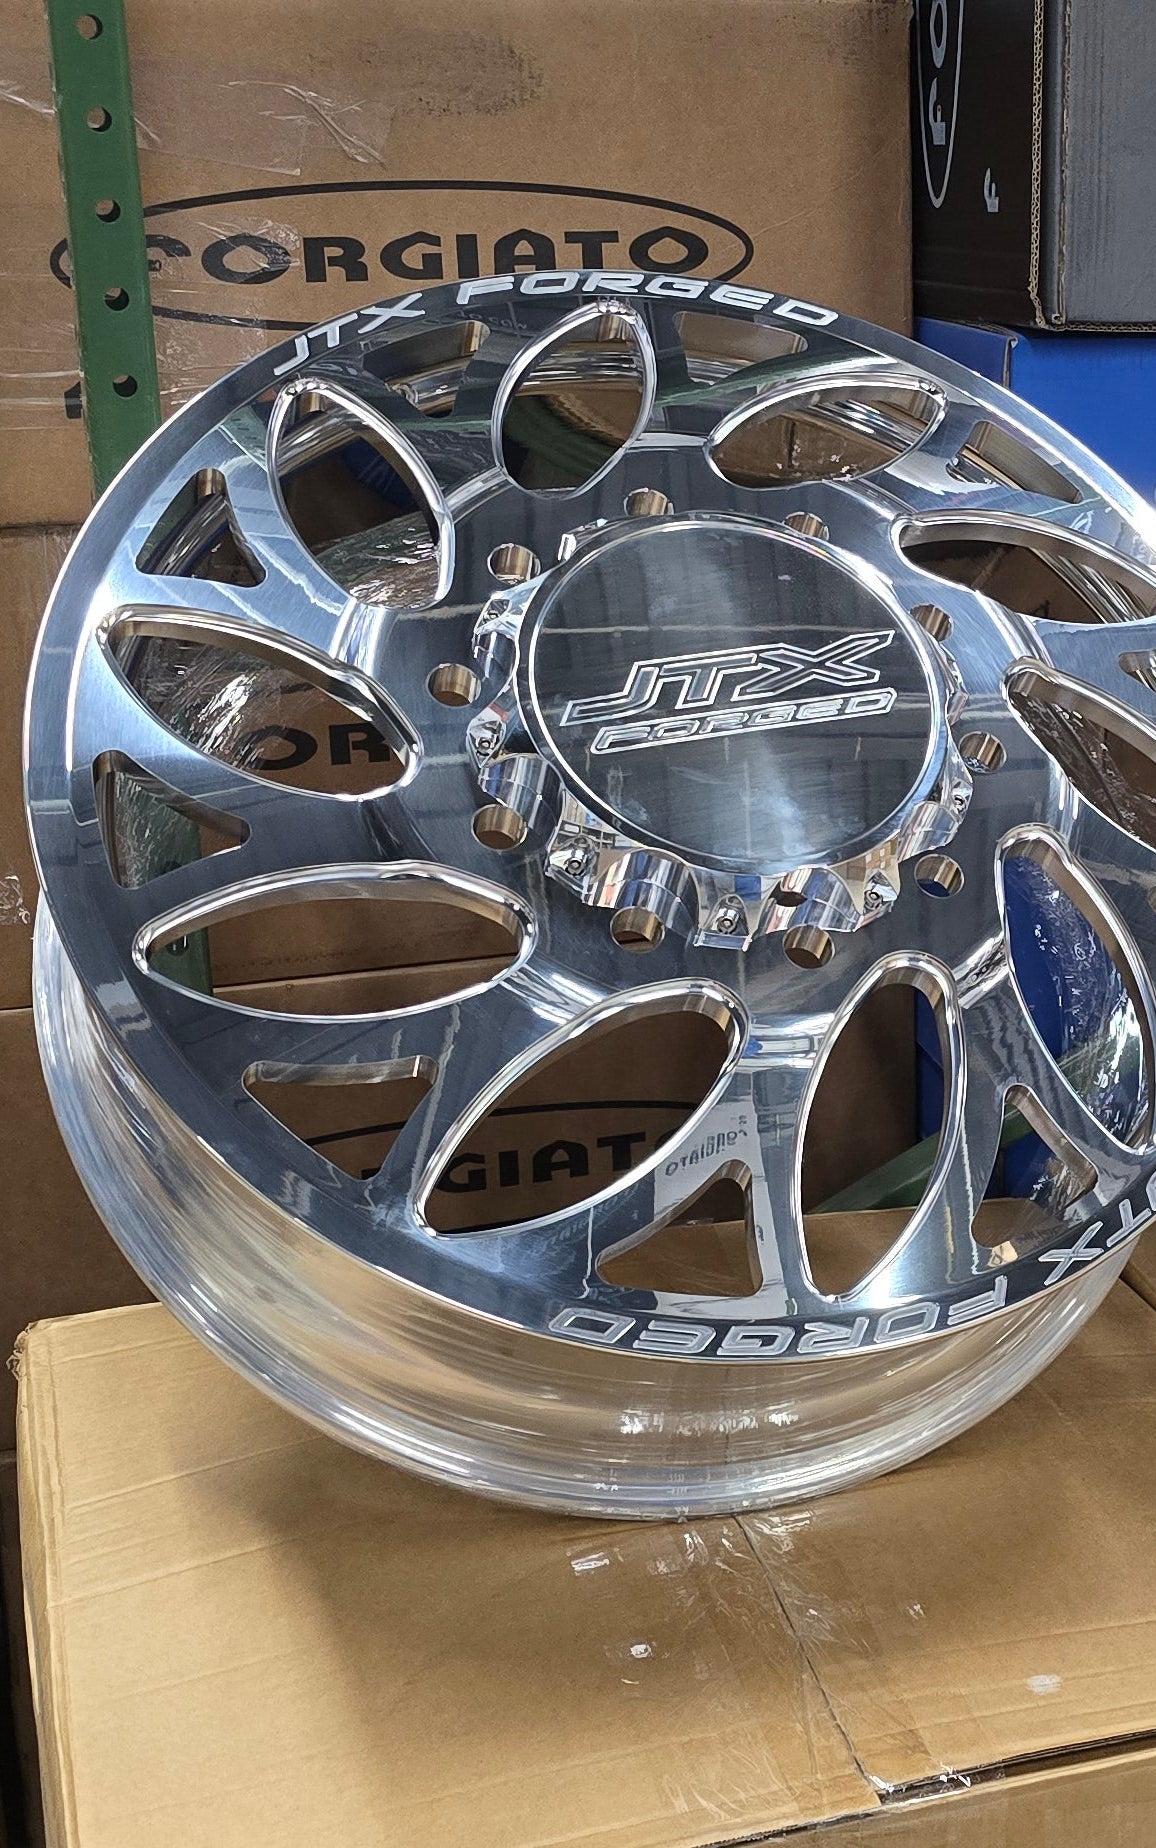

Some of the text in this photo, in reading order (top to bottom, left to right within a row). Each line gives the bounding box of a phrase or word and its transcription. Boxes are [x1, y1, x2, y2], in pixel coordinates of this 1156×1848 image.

[272, 272, 840, 376] JTX FORGED
[560, 629, 896, 727] JTX
[590, 687, 898, 755] FORGED
[547, 1275, 1008, 1358] FORGED
